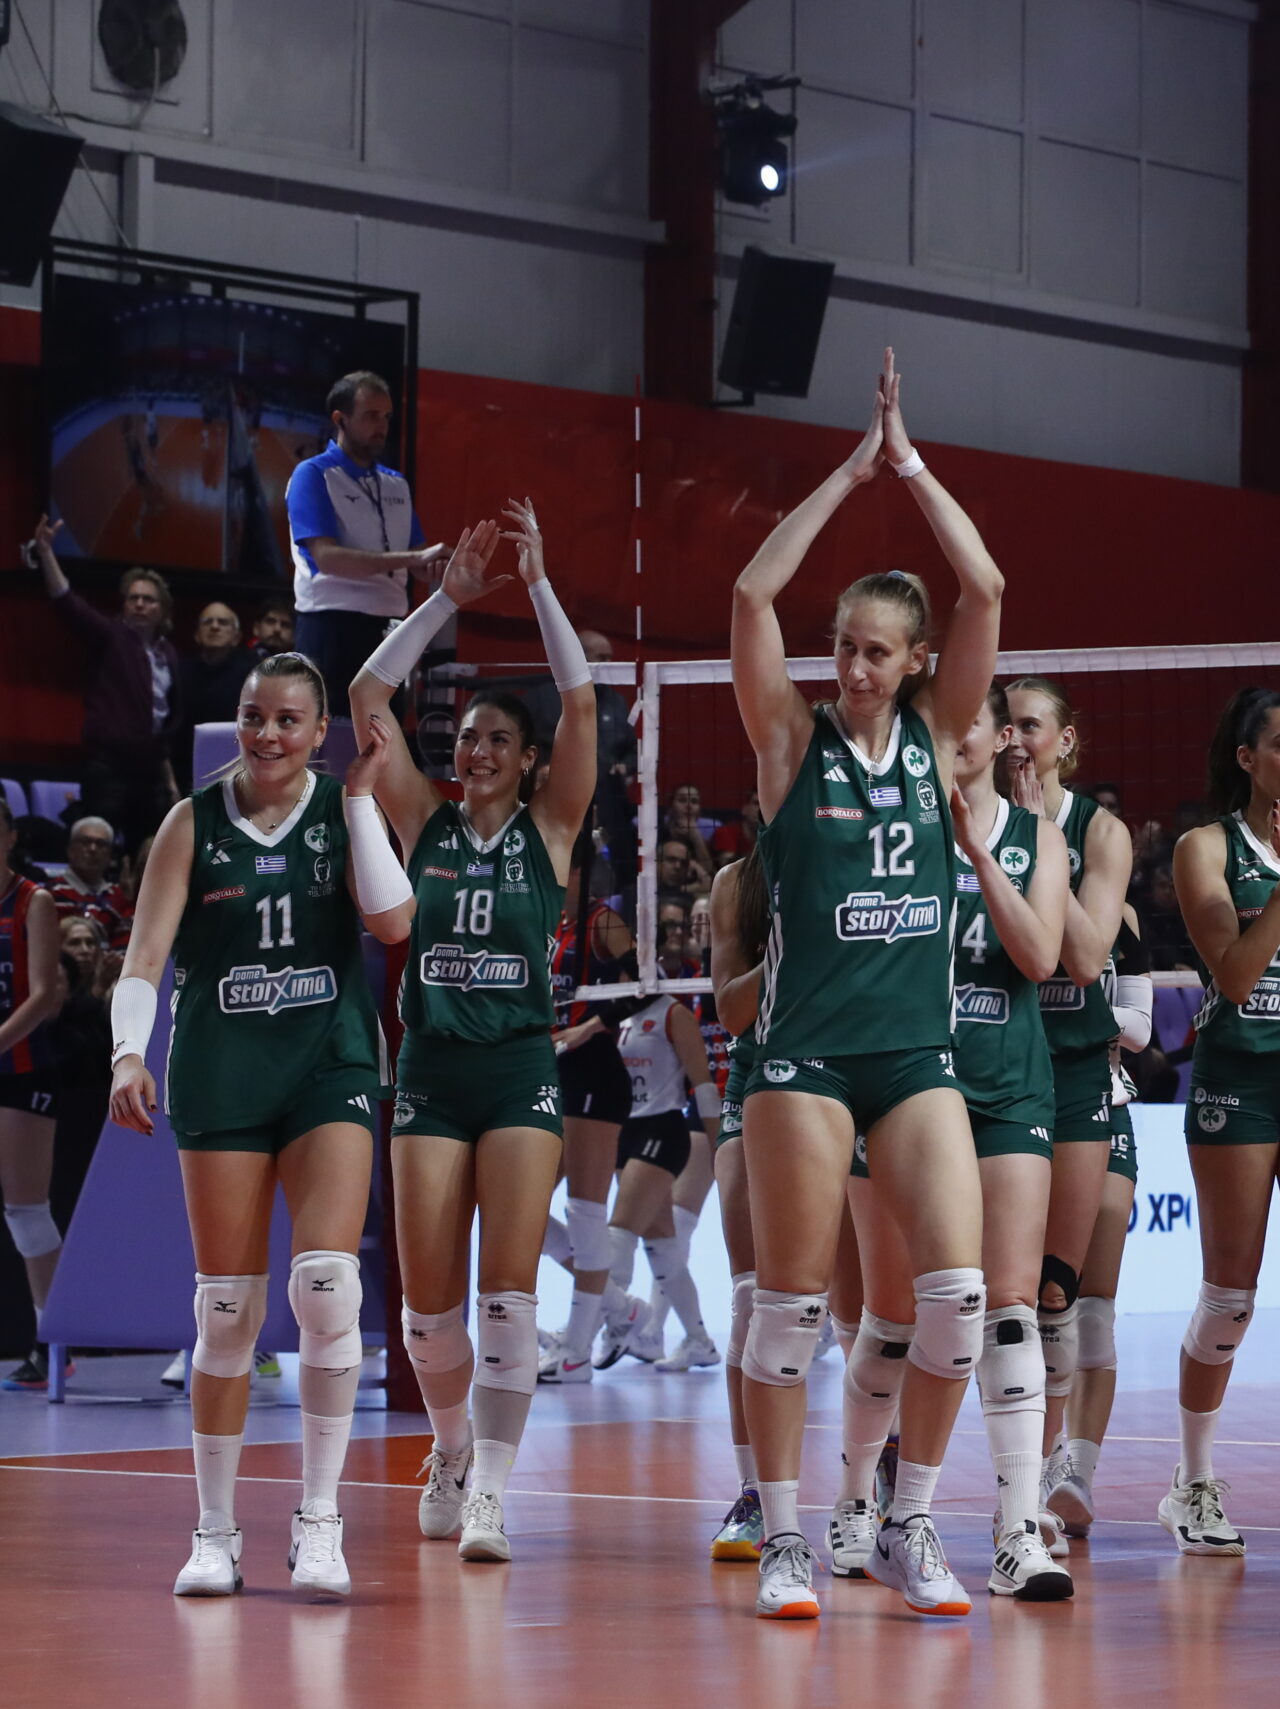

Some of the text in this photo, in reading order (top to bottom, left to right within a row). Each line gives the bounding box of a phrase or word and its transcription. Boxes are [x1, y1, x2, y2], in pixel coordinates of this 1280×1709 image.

[817, 807, 863, 819] BOROTALCO
[868, 821, 915, 877] 12
[852, 897, 879, 908] pame
[452, 888, 495, 936] 18
[255, 892, 297, 950] 11
[436, 947, 458, 957] pame
[234, 969, 261, 981] pame
[1254, 981, 1278, 991] pame
[32, 1091, 52, 1113] 17
[642, 1139, 662, 1159] 11
